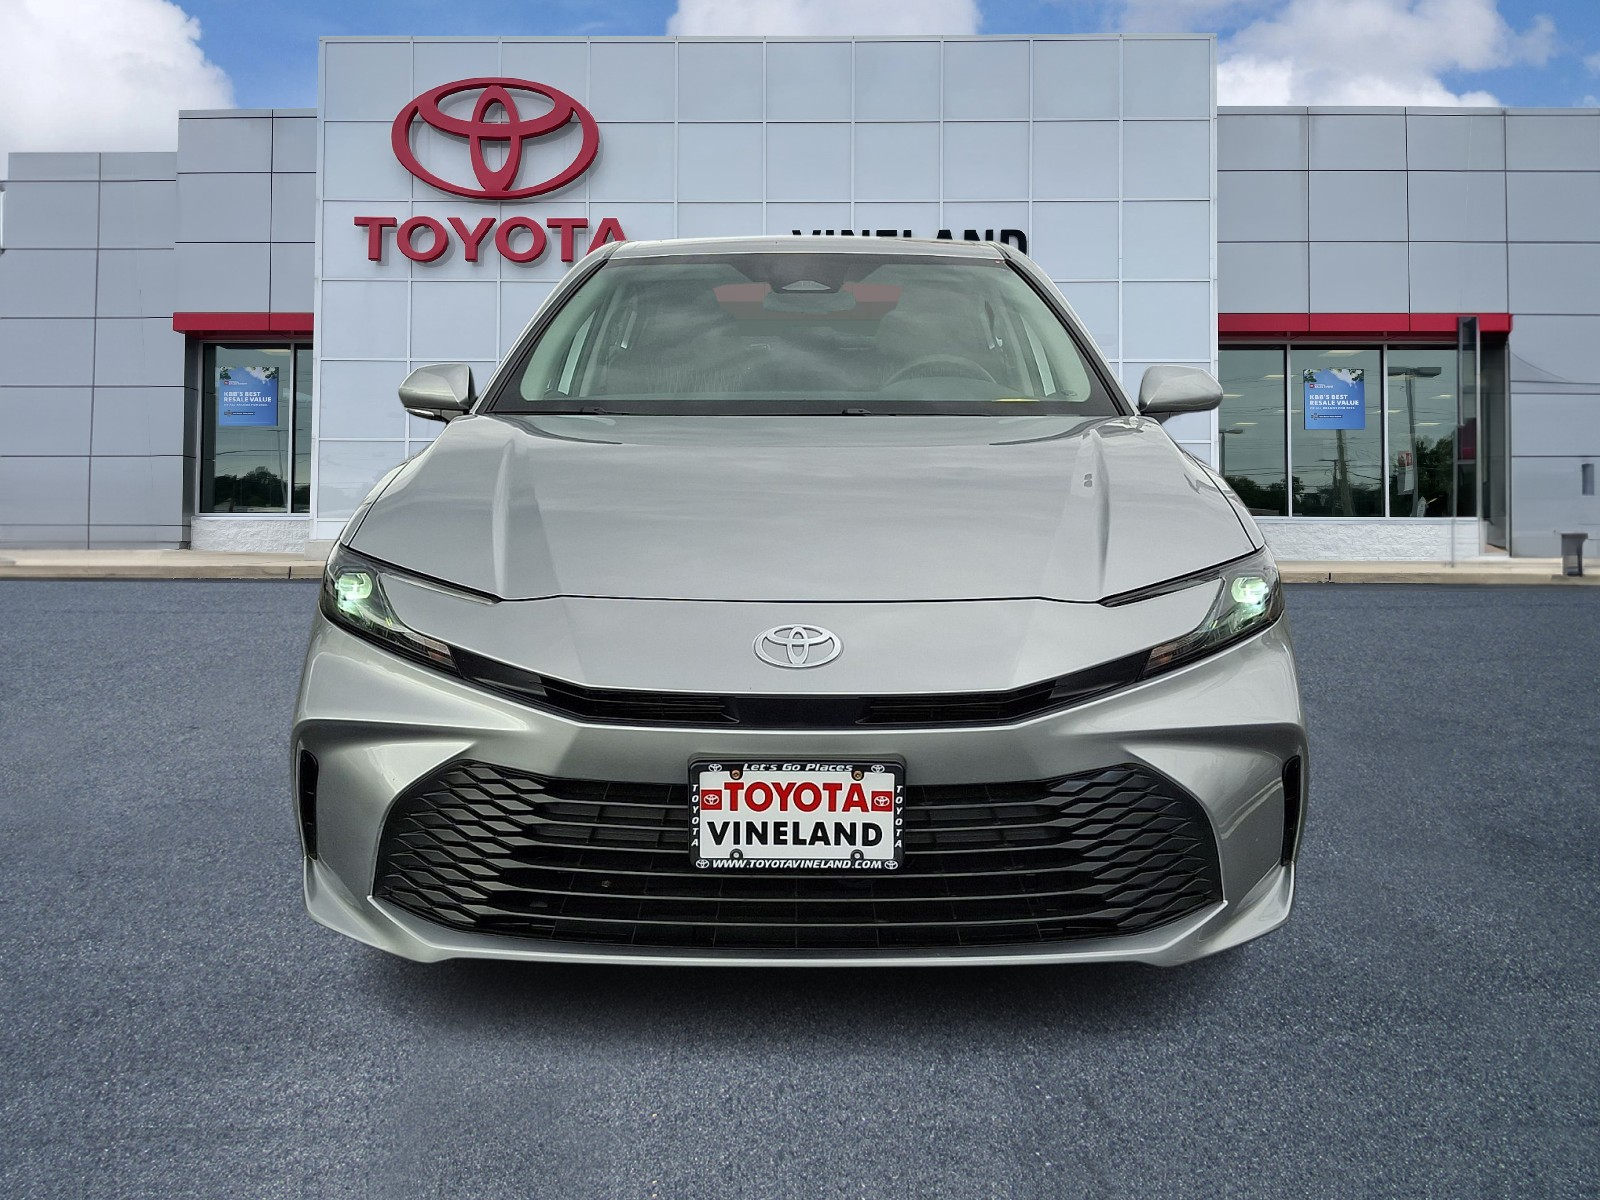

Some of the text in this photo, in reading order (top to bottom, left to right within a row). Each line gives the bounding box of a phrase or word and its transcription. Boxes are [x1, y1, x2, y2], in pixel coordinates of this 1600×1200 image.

[354, 216, 627, 262] TOYOTA
[743, 763, 853, 772] Let's Go Places
[724, 781, 870, 812] TOYOTA
[690, 784, 699, 847] TOYOTA
[894, 785, 904, 848] TOYOTA
[707, 821, 883, 847] VINELAND
[712, 859, 882, 869] WWW.TOYOTAVINELAND.COM
